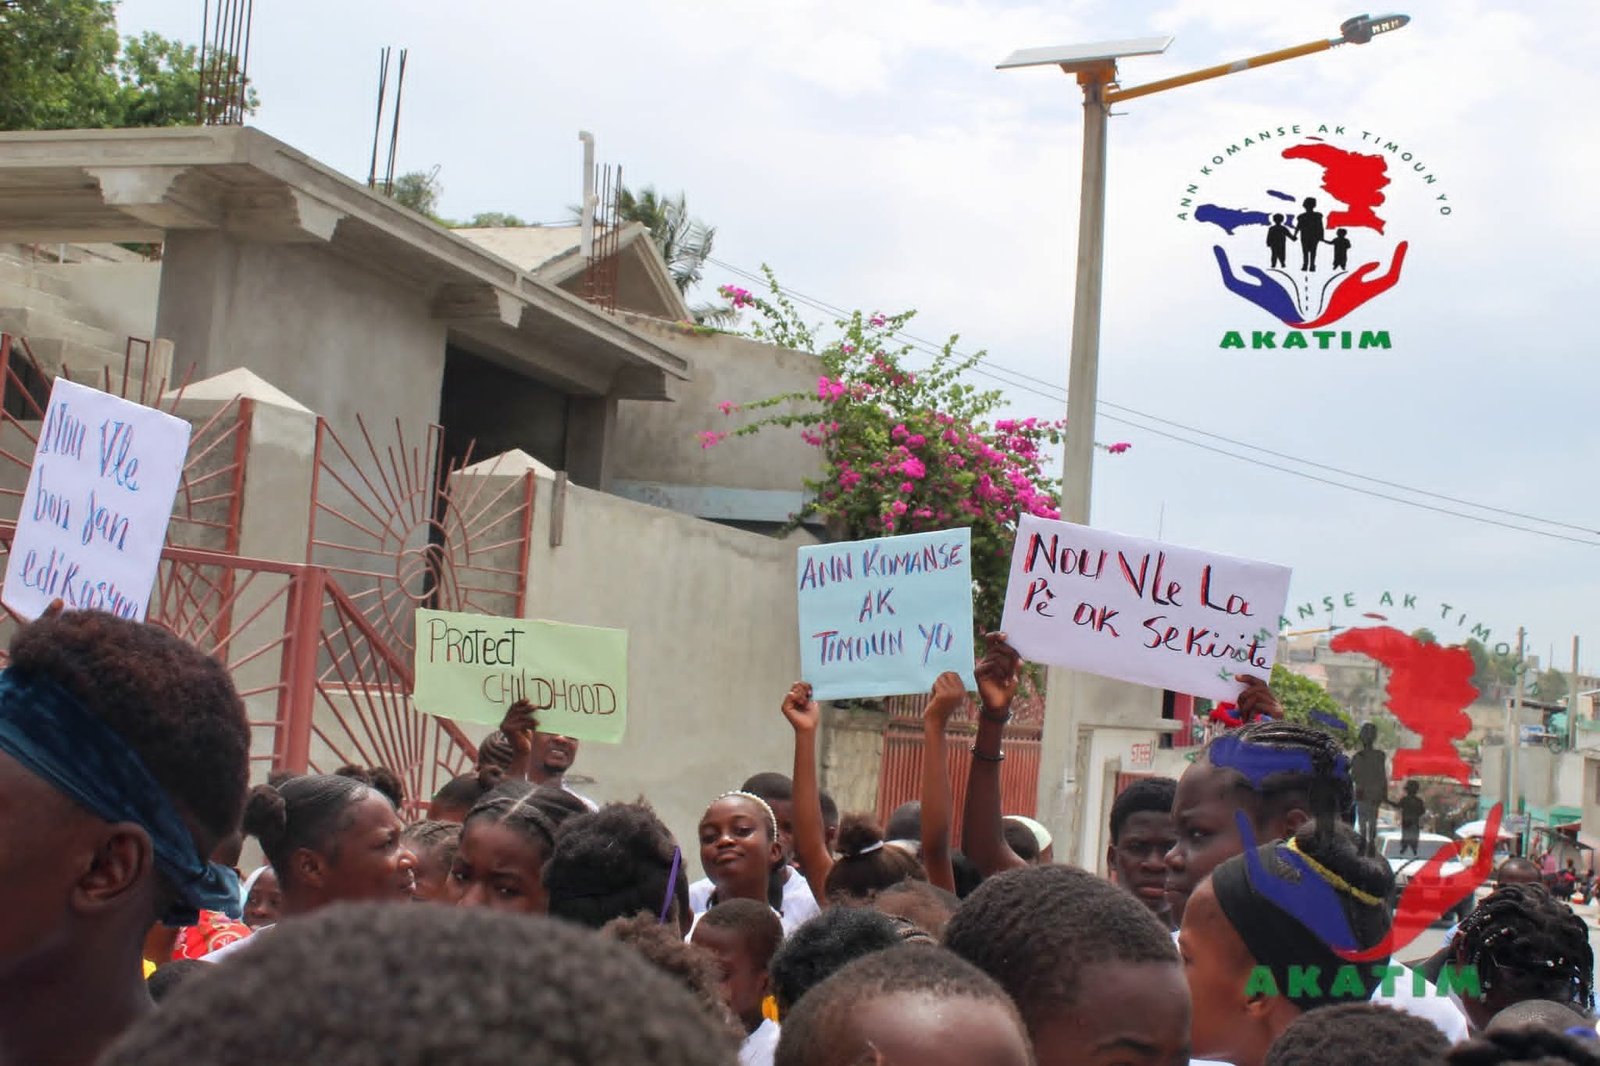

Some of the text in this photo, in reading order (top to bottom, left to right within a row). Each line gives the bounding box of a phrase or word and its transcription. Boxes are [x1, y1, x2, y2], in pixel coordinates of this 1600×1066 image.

[33, 463, 71, 531] bon
[800, 543, 964, 592] ANN KOMANSE
[1200, 564, 1254, 617] La
[858, 586, 897, 623] AK
[918, 622, 954, 669] YO
